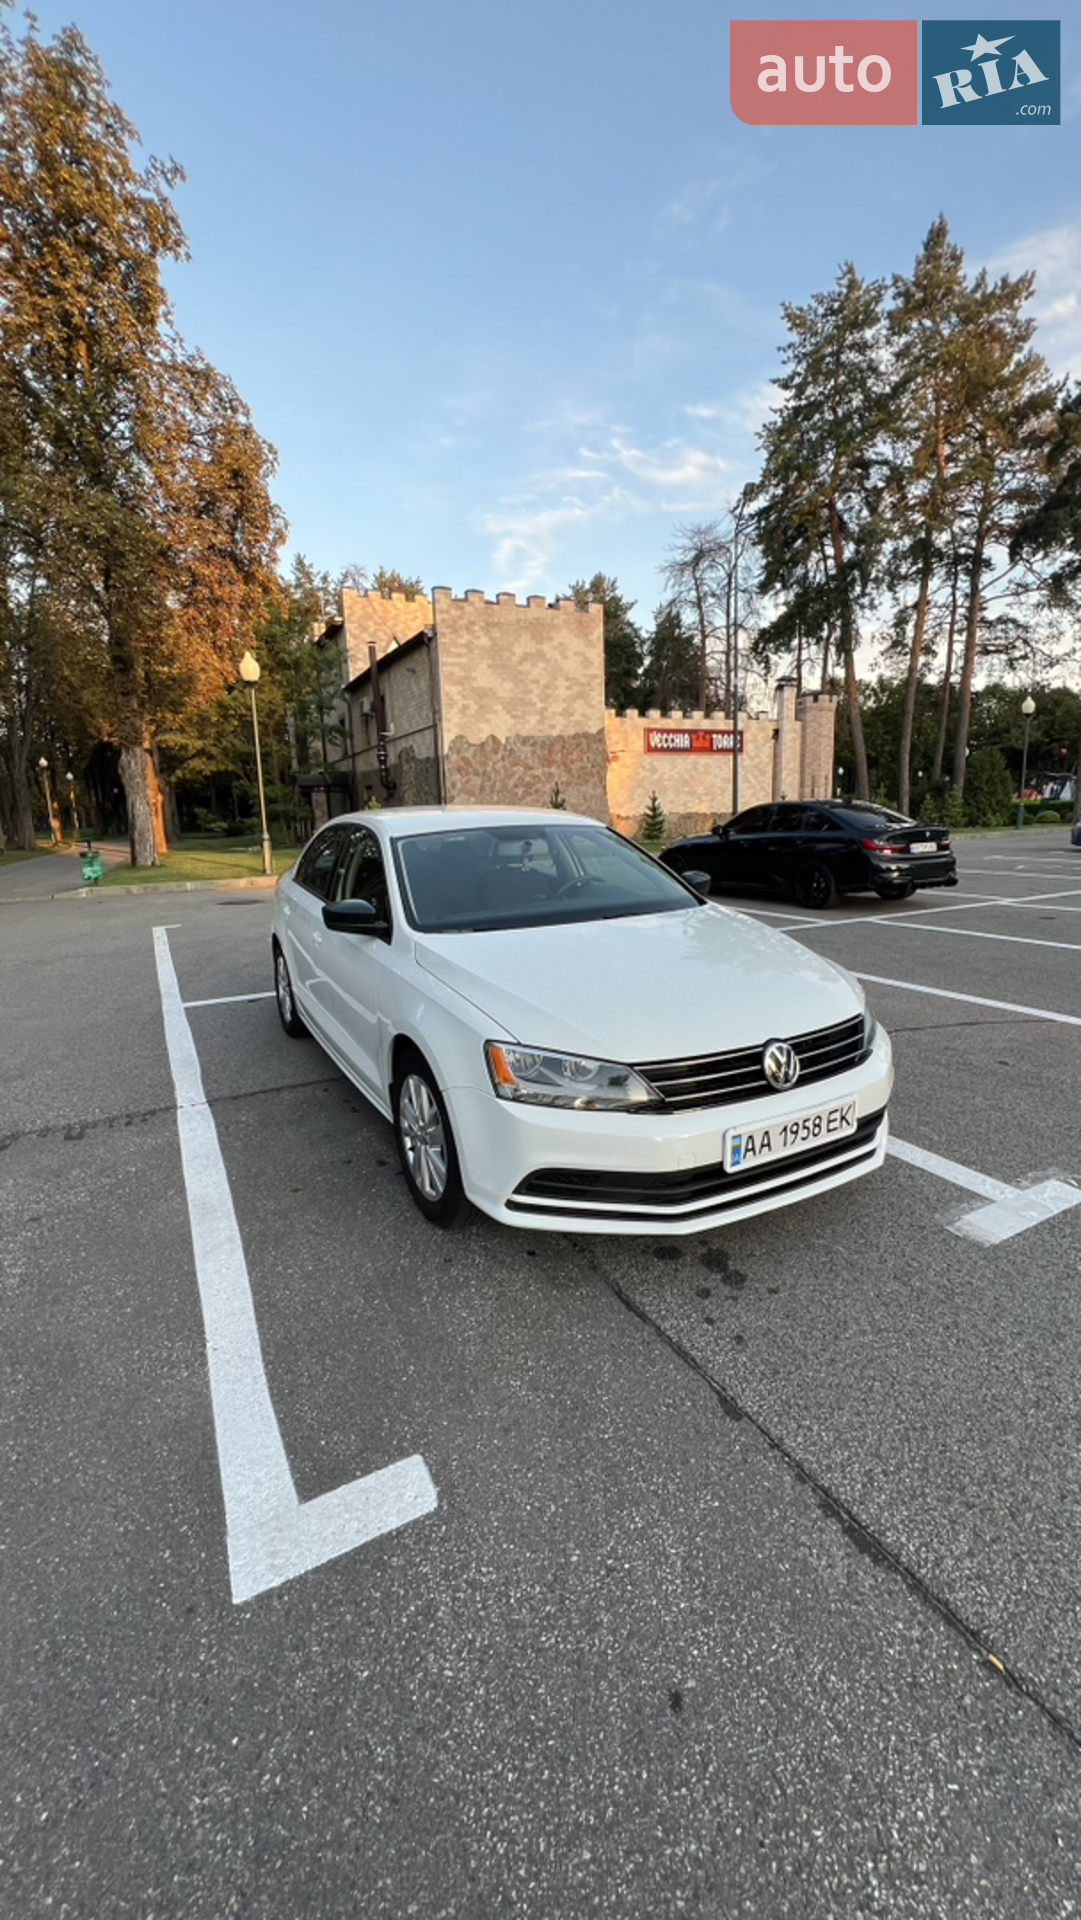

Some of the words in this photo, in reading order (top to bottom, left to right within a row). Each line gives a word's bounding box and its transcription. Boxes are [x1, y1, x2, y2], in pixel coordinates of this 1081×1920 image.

[743, 1130, 772, 1160] AA
[779, 1115, 822, 1147] 1958
[827, 1104, 853, 1133] EK
